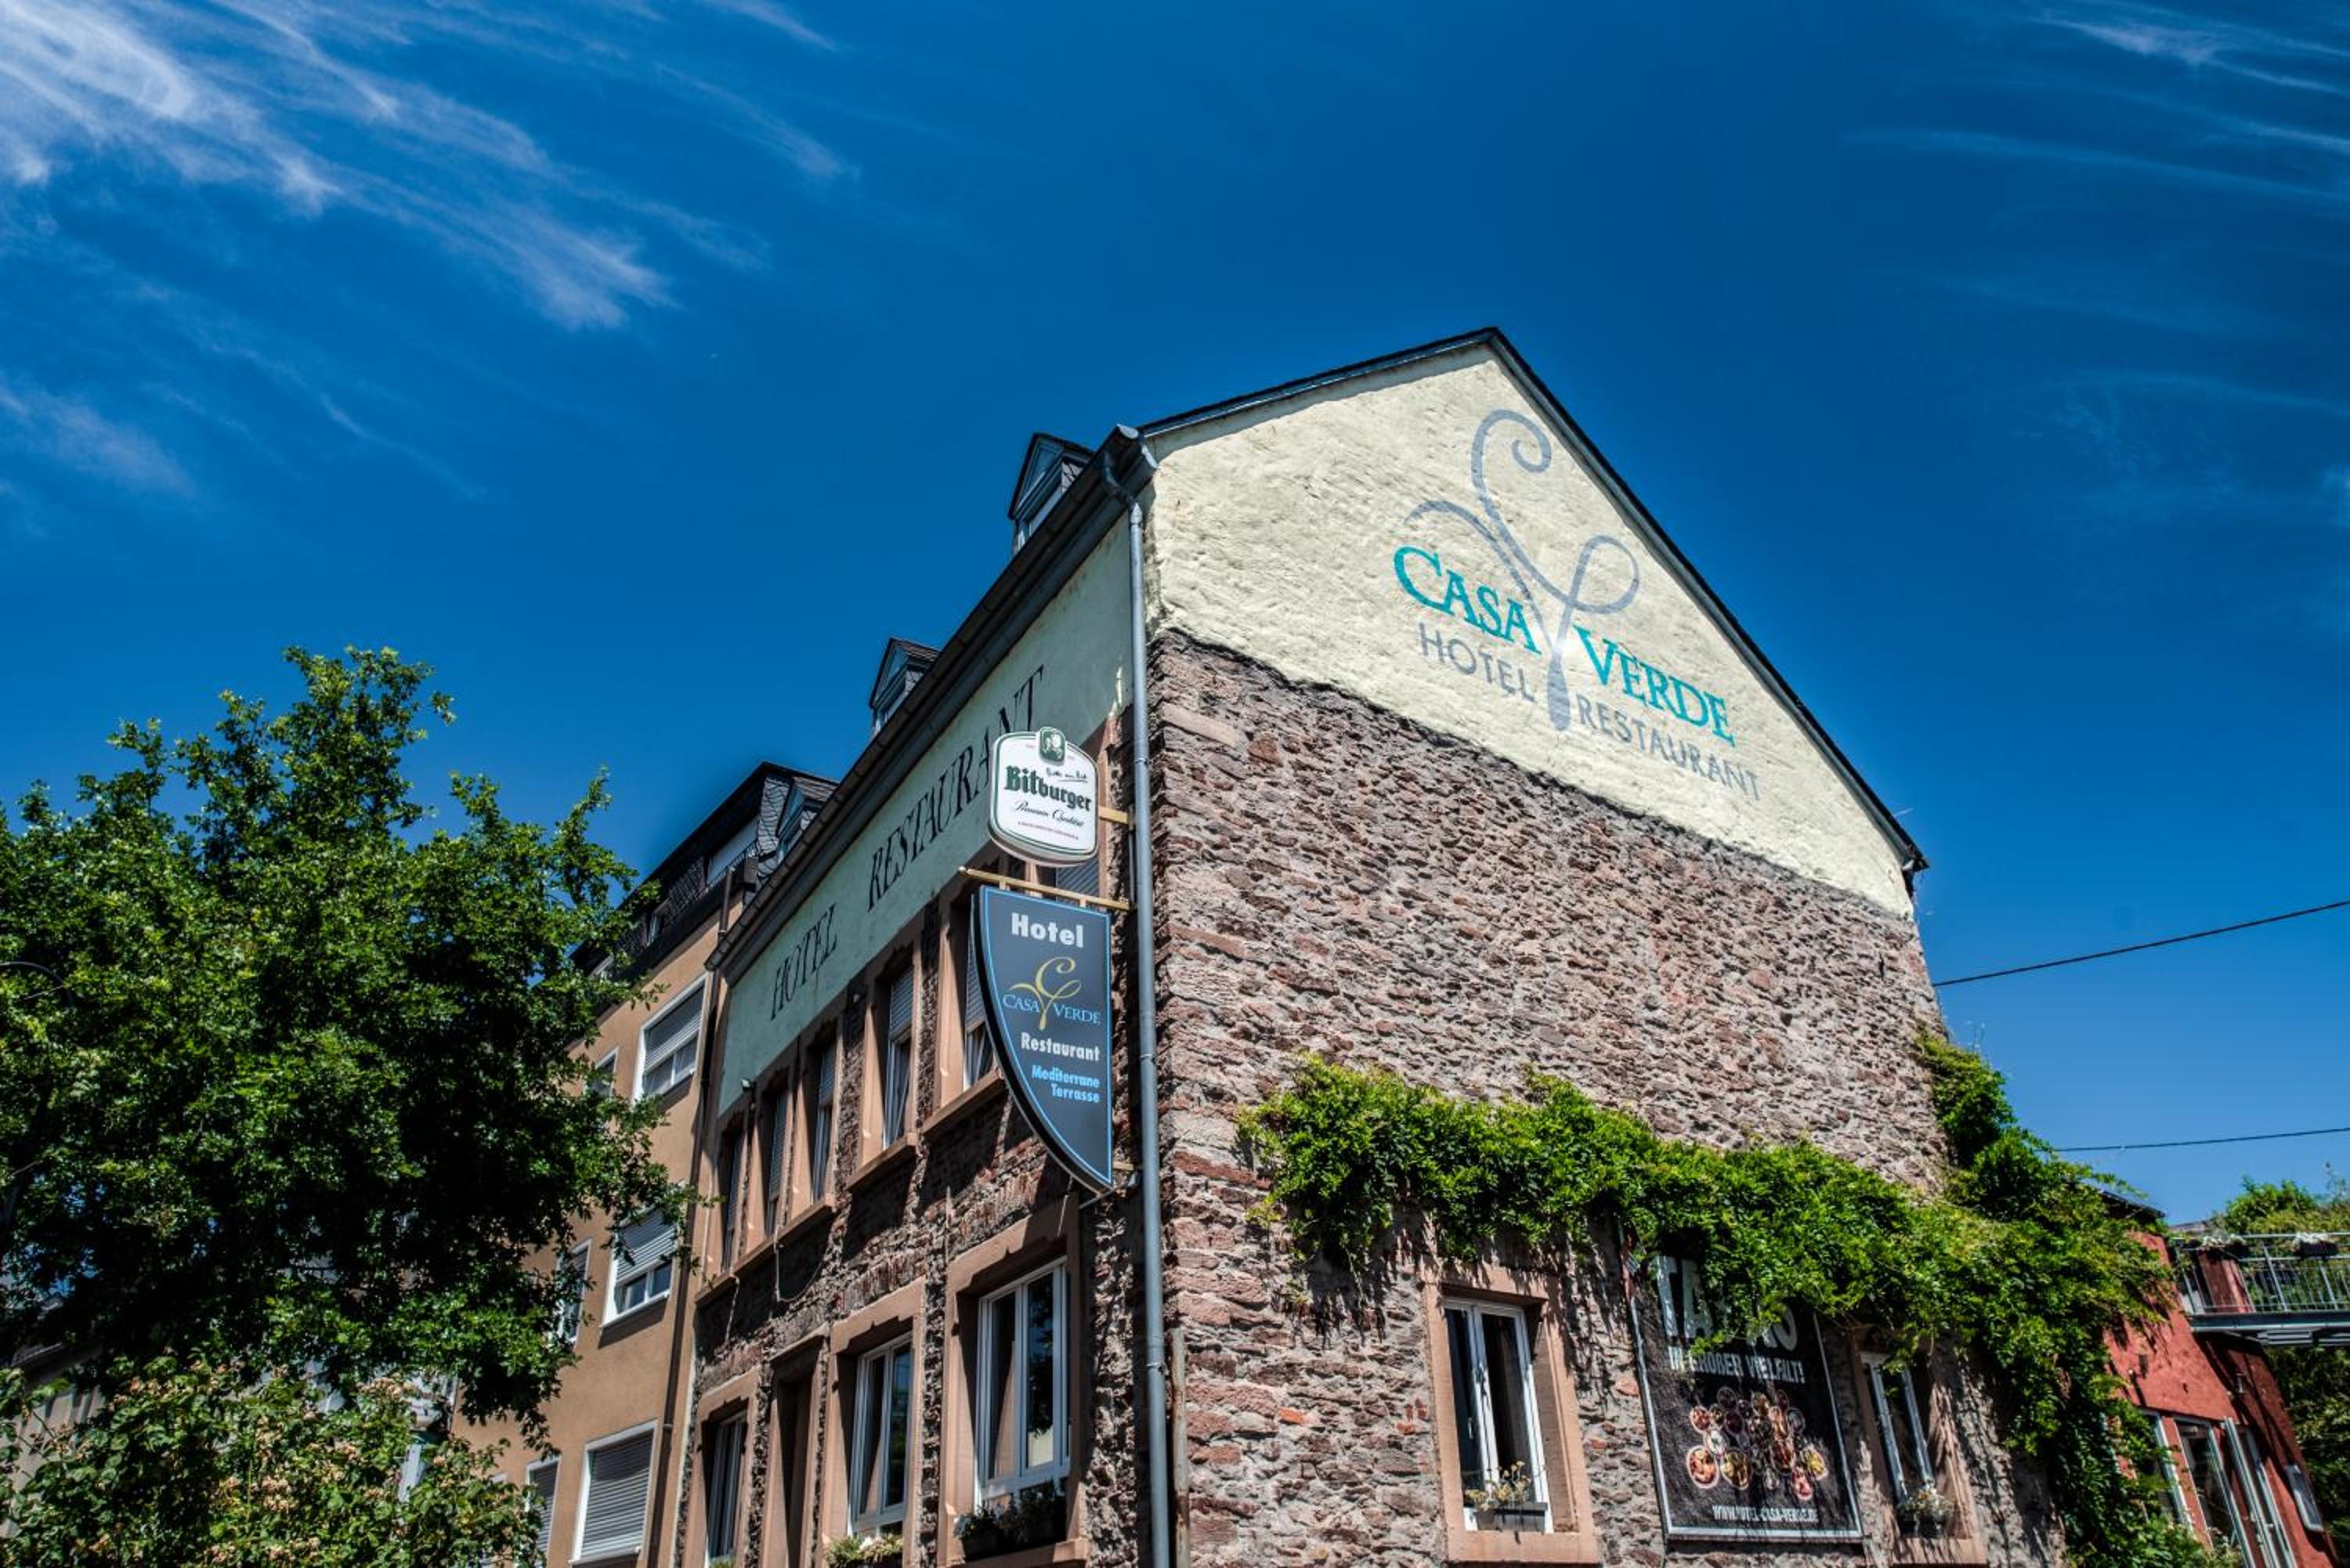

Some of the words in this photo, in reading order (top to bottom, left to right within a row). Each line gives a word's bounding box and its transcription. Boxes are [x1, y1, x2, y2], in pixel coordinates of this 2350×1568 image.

[1394, 546, 1542, 656] CASA
[1573, 624, 1735, 747] VERDE
[1419, 622, 1535, 703] HOTEL
[1575, 693, 1761, 800] RESTAURANT
[1003, 765, 1092, 812] Bitburger
[1011, 912, 1084, 948] Hotel
[771, 902, 837, 1021] HOTEL
[1003, 994, 1040, 1013] CASA
[1053, 1002, 1101, 1025] VERDE
[1021, 1031, 1101, 1061] Restaurant
[1032, 1064, 1100, 1088] Mediterrane
[1051, 1082, 1100, 1103] Terrasse
